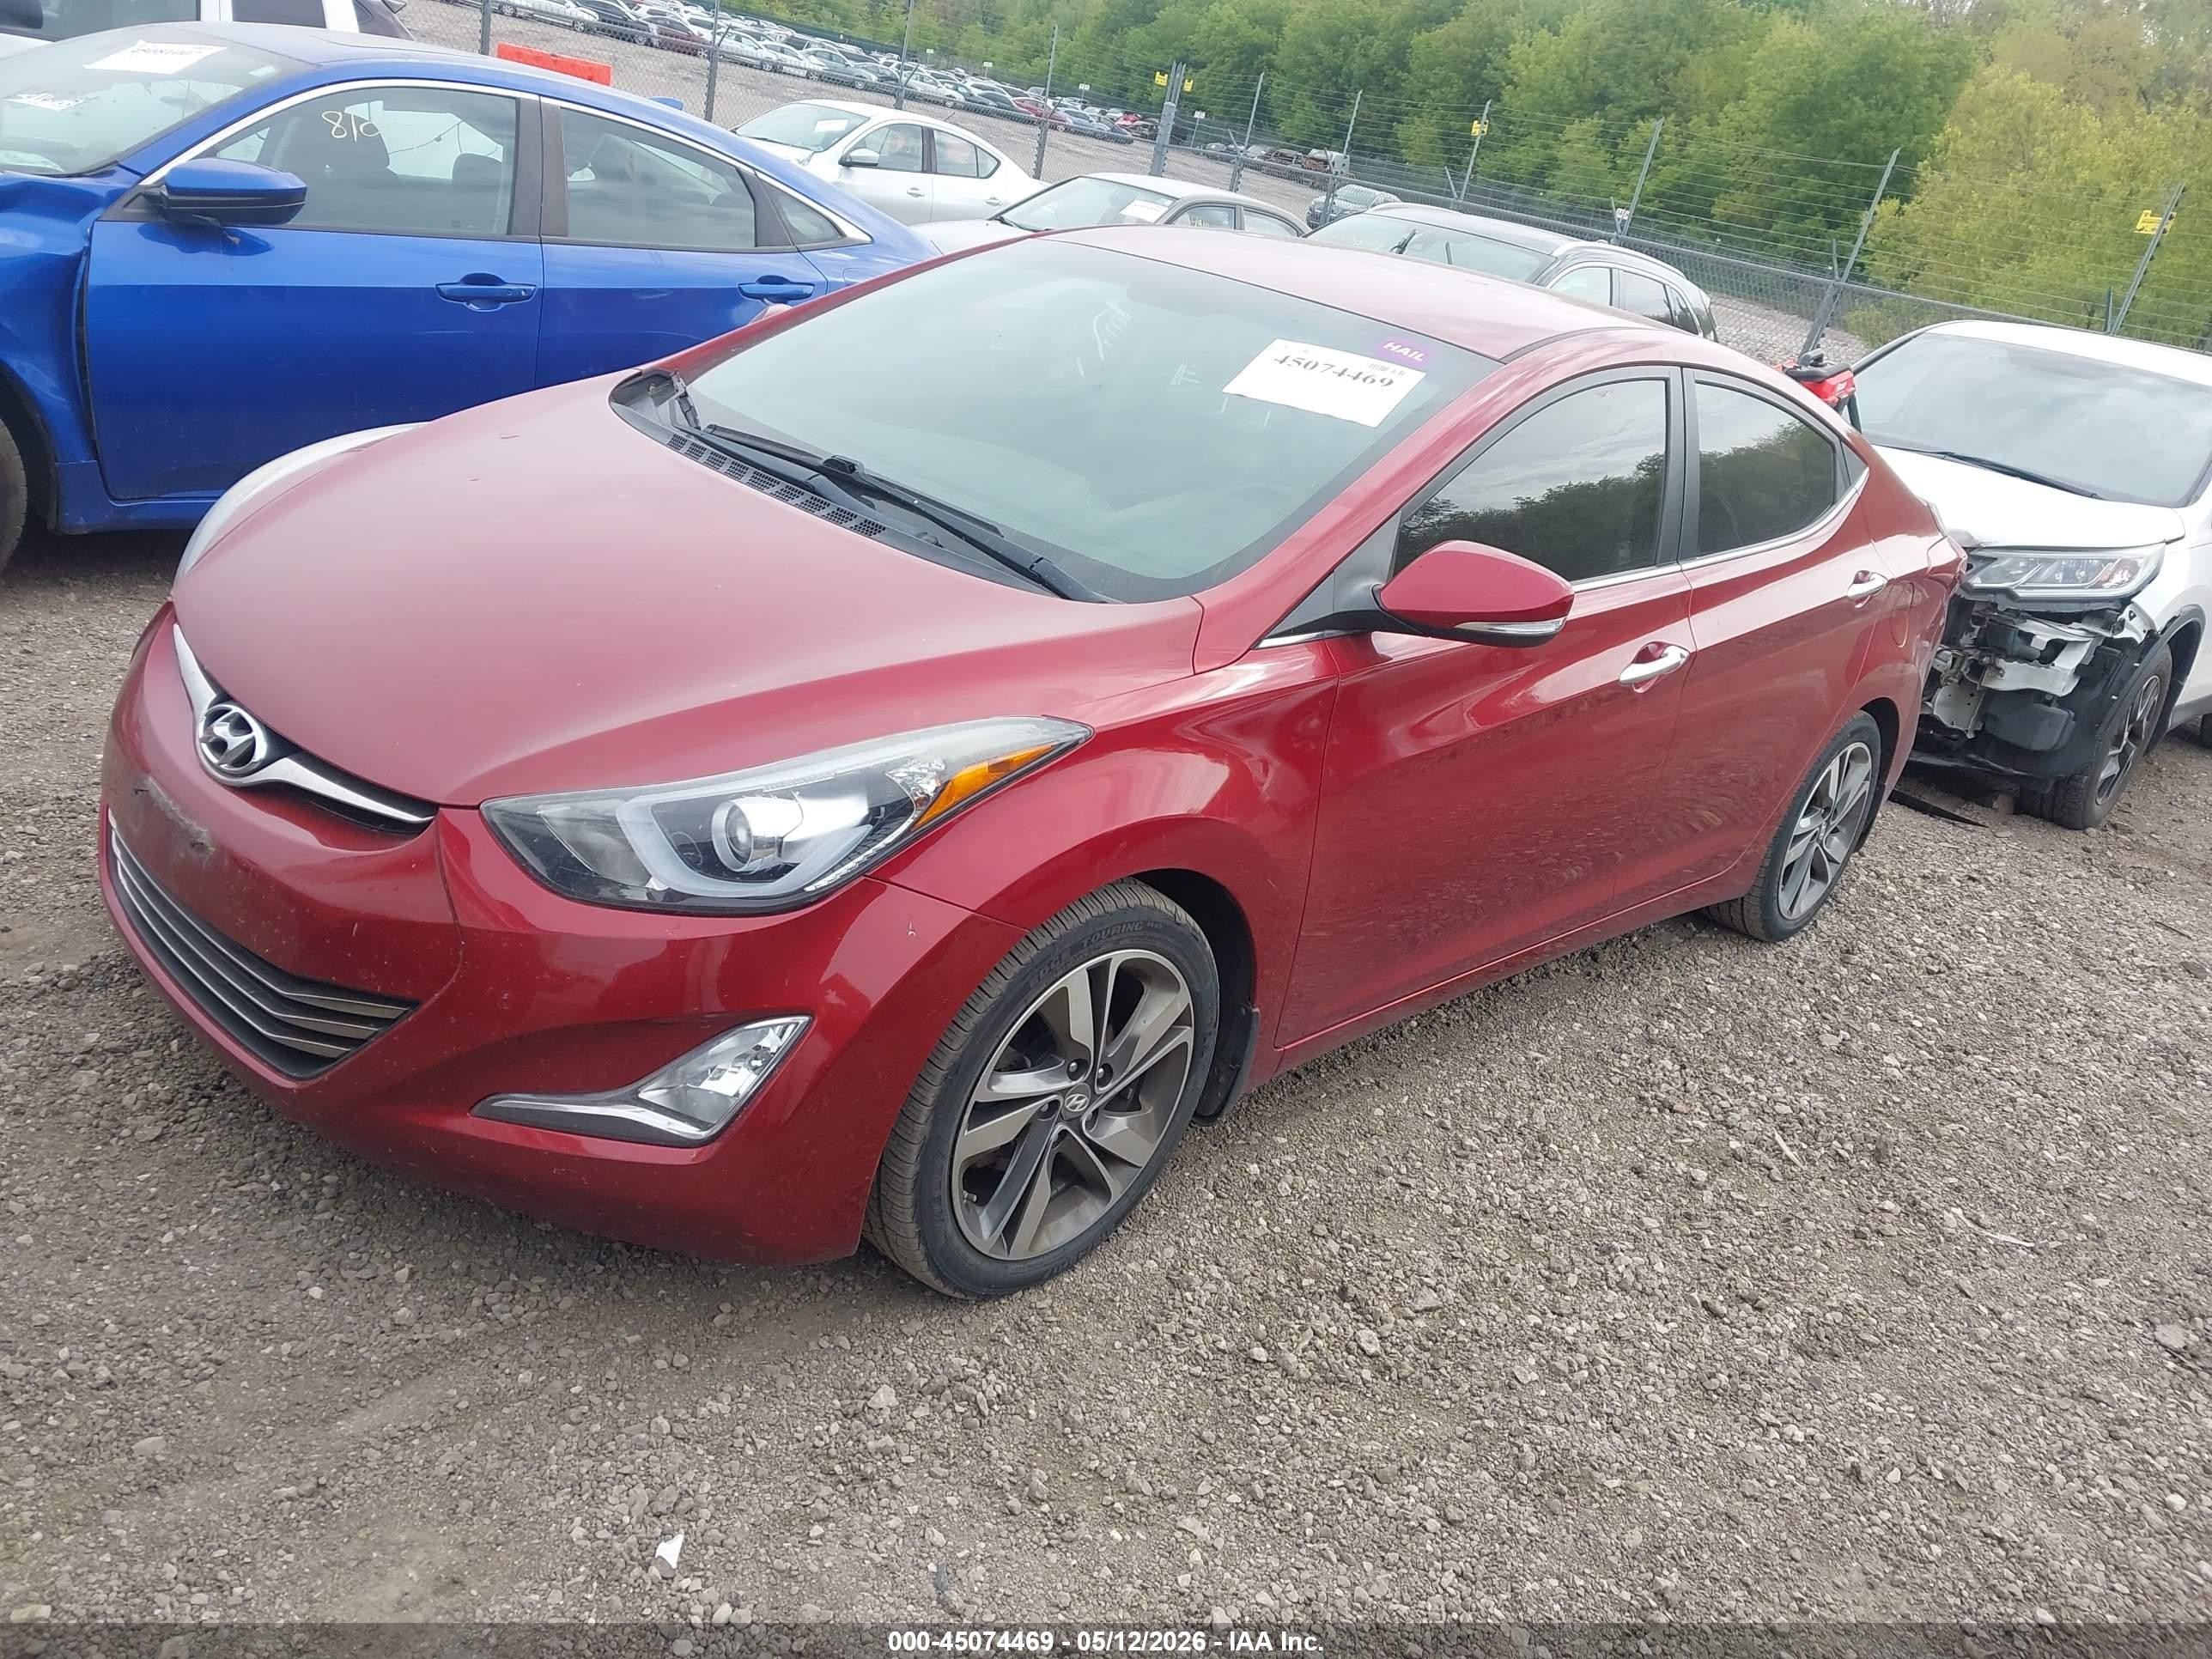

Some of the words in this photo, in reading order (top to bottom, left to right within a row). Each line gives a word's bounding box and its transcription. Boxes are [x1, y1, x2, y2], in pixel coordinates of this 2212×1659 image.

[1382, 341, 1424, 362] HAIL
[1273, 355, 1395, 386] 45074469
[1083, 920, 1144, 947] TOURING
